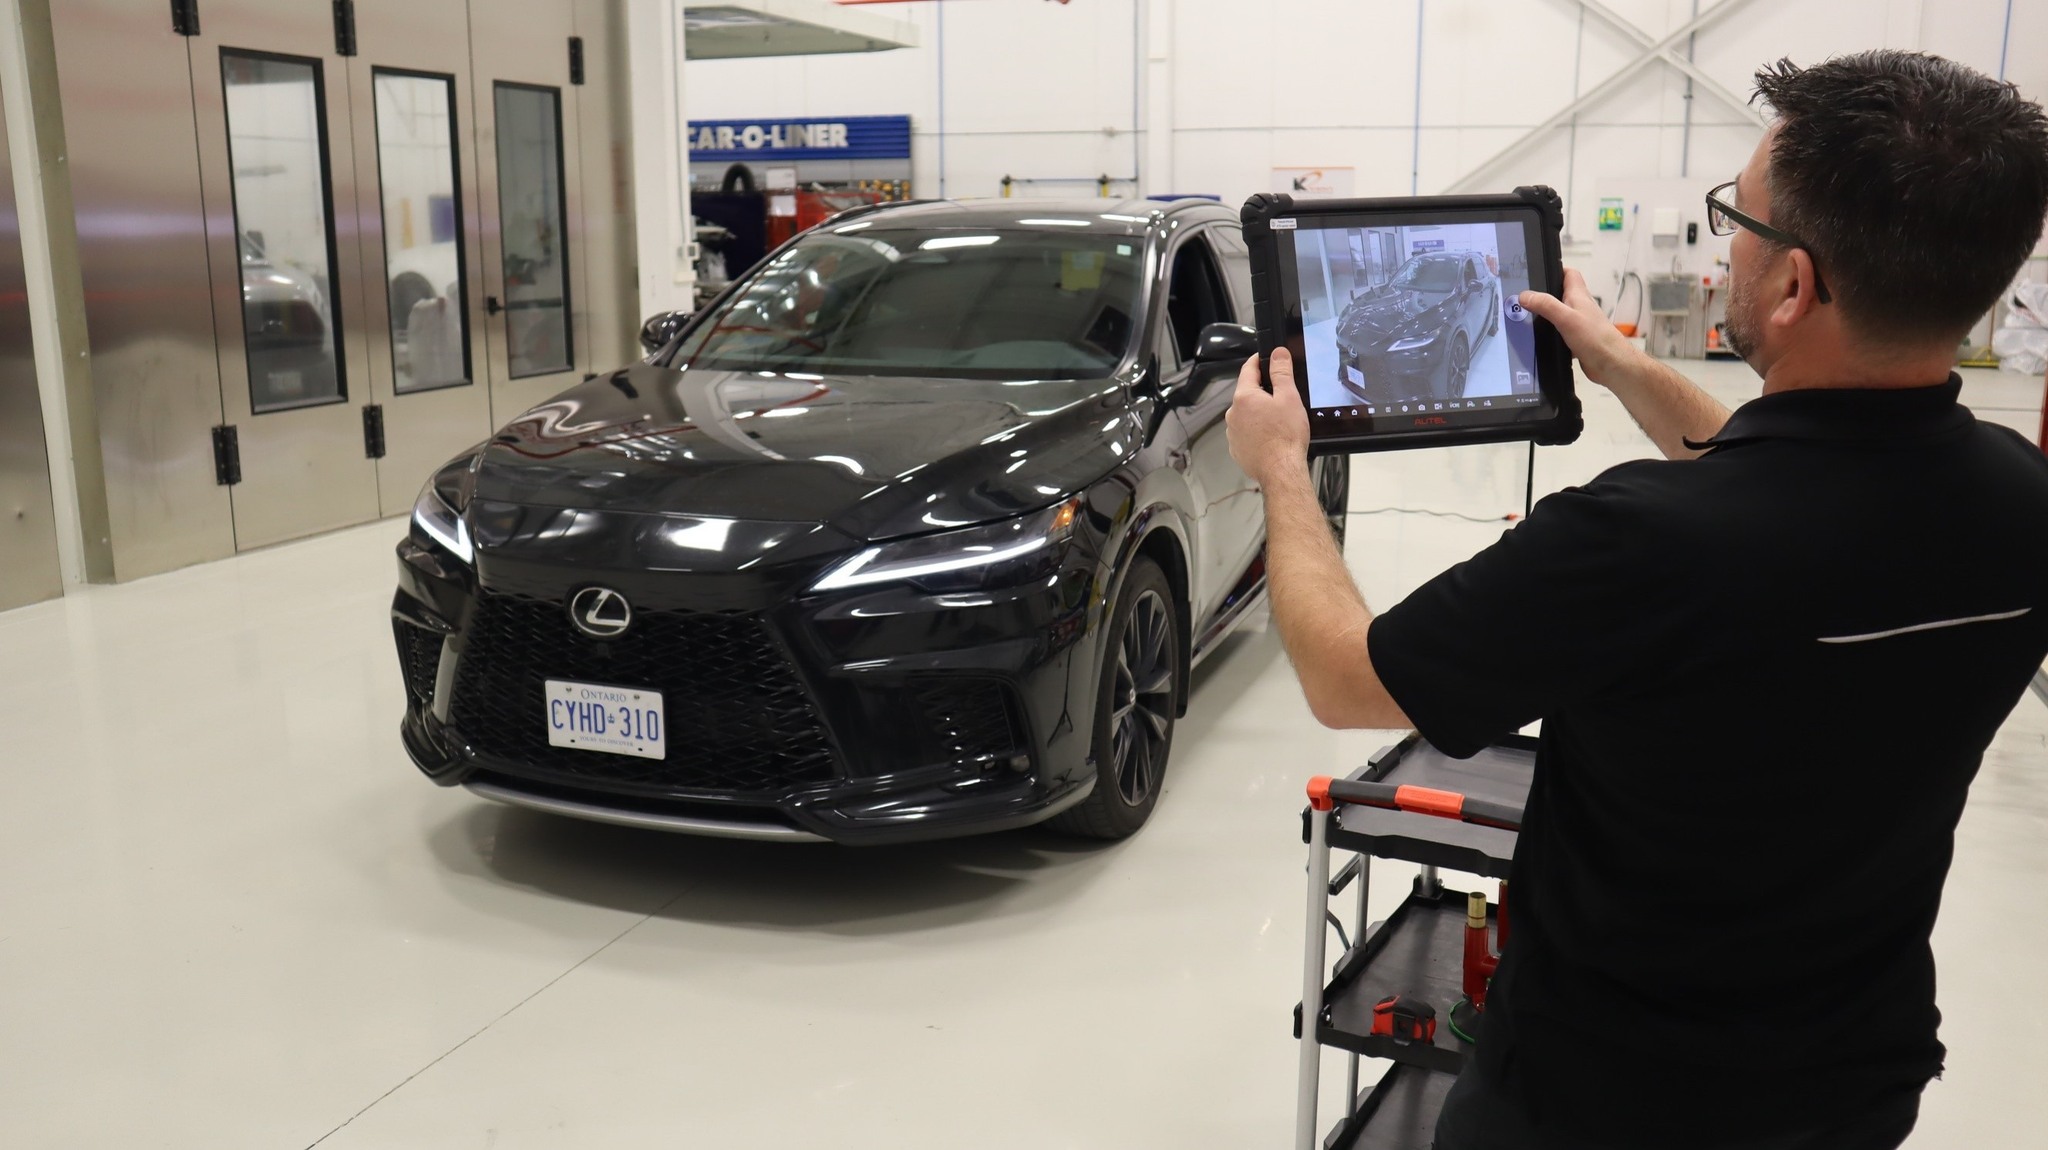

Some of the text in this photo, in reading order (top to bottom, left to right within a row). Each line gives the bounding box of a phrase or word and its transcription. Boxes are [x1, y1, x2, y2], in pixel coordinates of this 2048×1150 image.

[1414, 417, 1447, 426] AUTEL
[551, 699, 659, 741] CYHD 310
